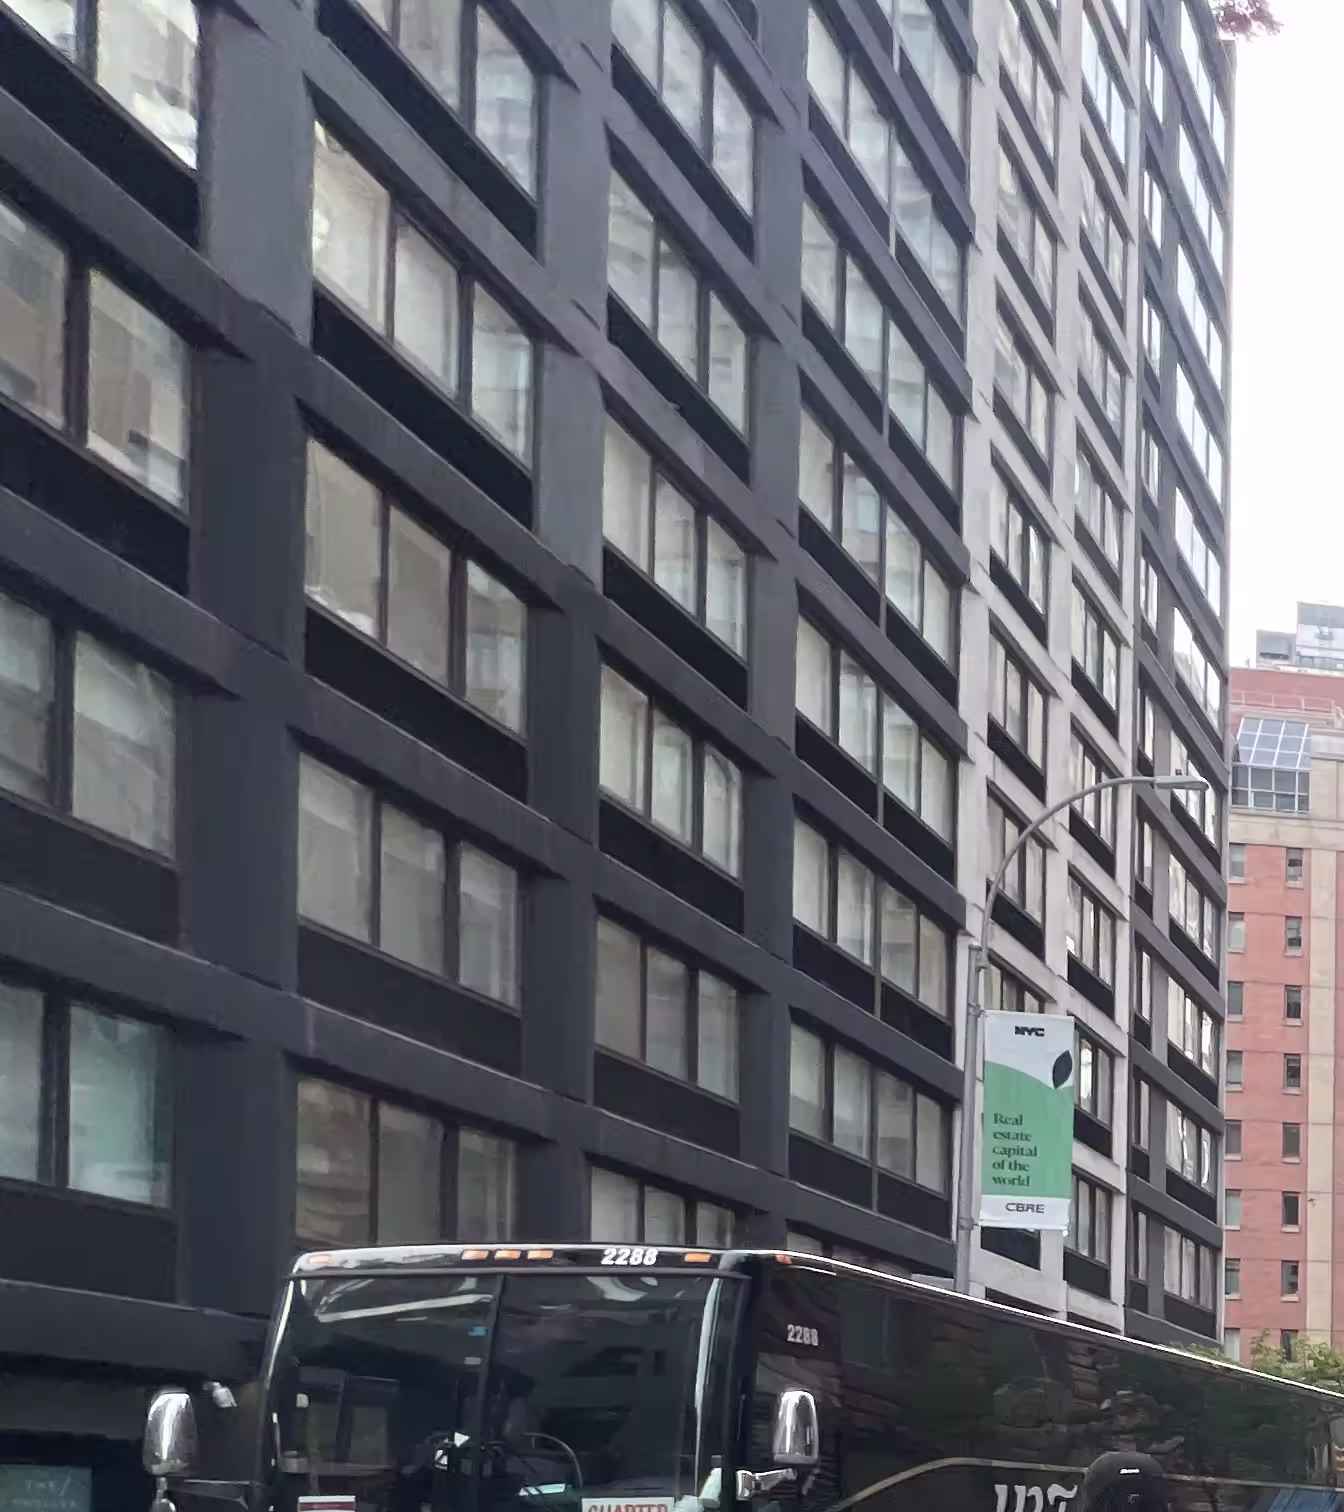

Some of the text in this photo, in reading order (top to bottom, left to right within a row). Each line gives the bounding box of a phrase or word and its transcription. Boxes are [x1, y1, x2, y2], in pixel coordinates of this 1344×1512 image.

[1014, 1025, 1045, 1037] NYC
[992, 1112, 1023, 1126] Real
[992, 1130, 1032, 1142] estate
[992, 1144, 1038, 1158] capital
[992, 1159, 1030, 1172] of the
[992, 1175, 1030, 1187] world
[1005, 1202, 1045, 1214] CBRE
[601, 1247, 659, 1266] 2288
